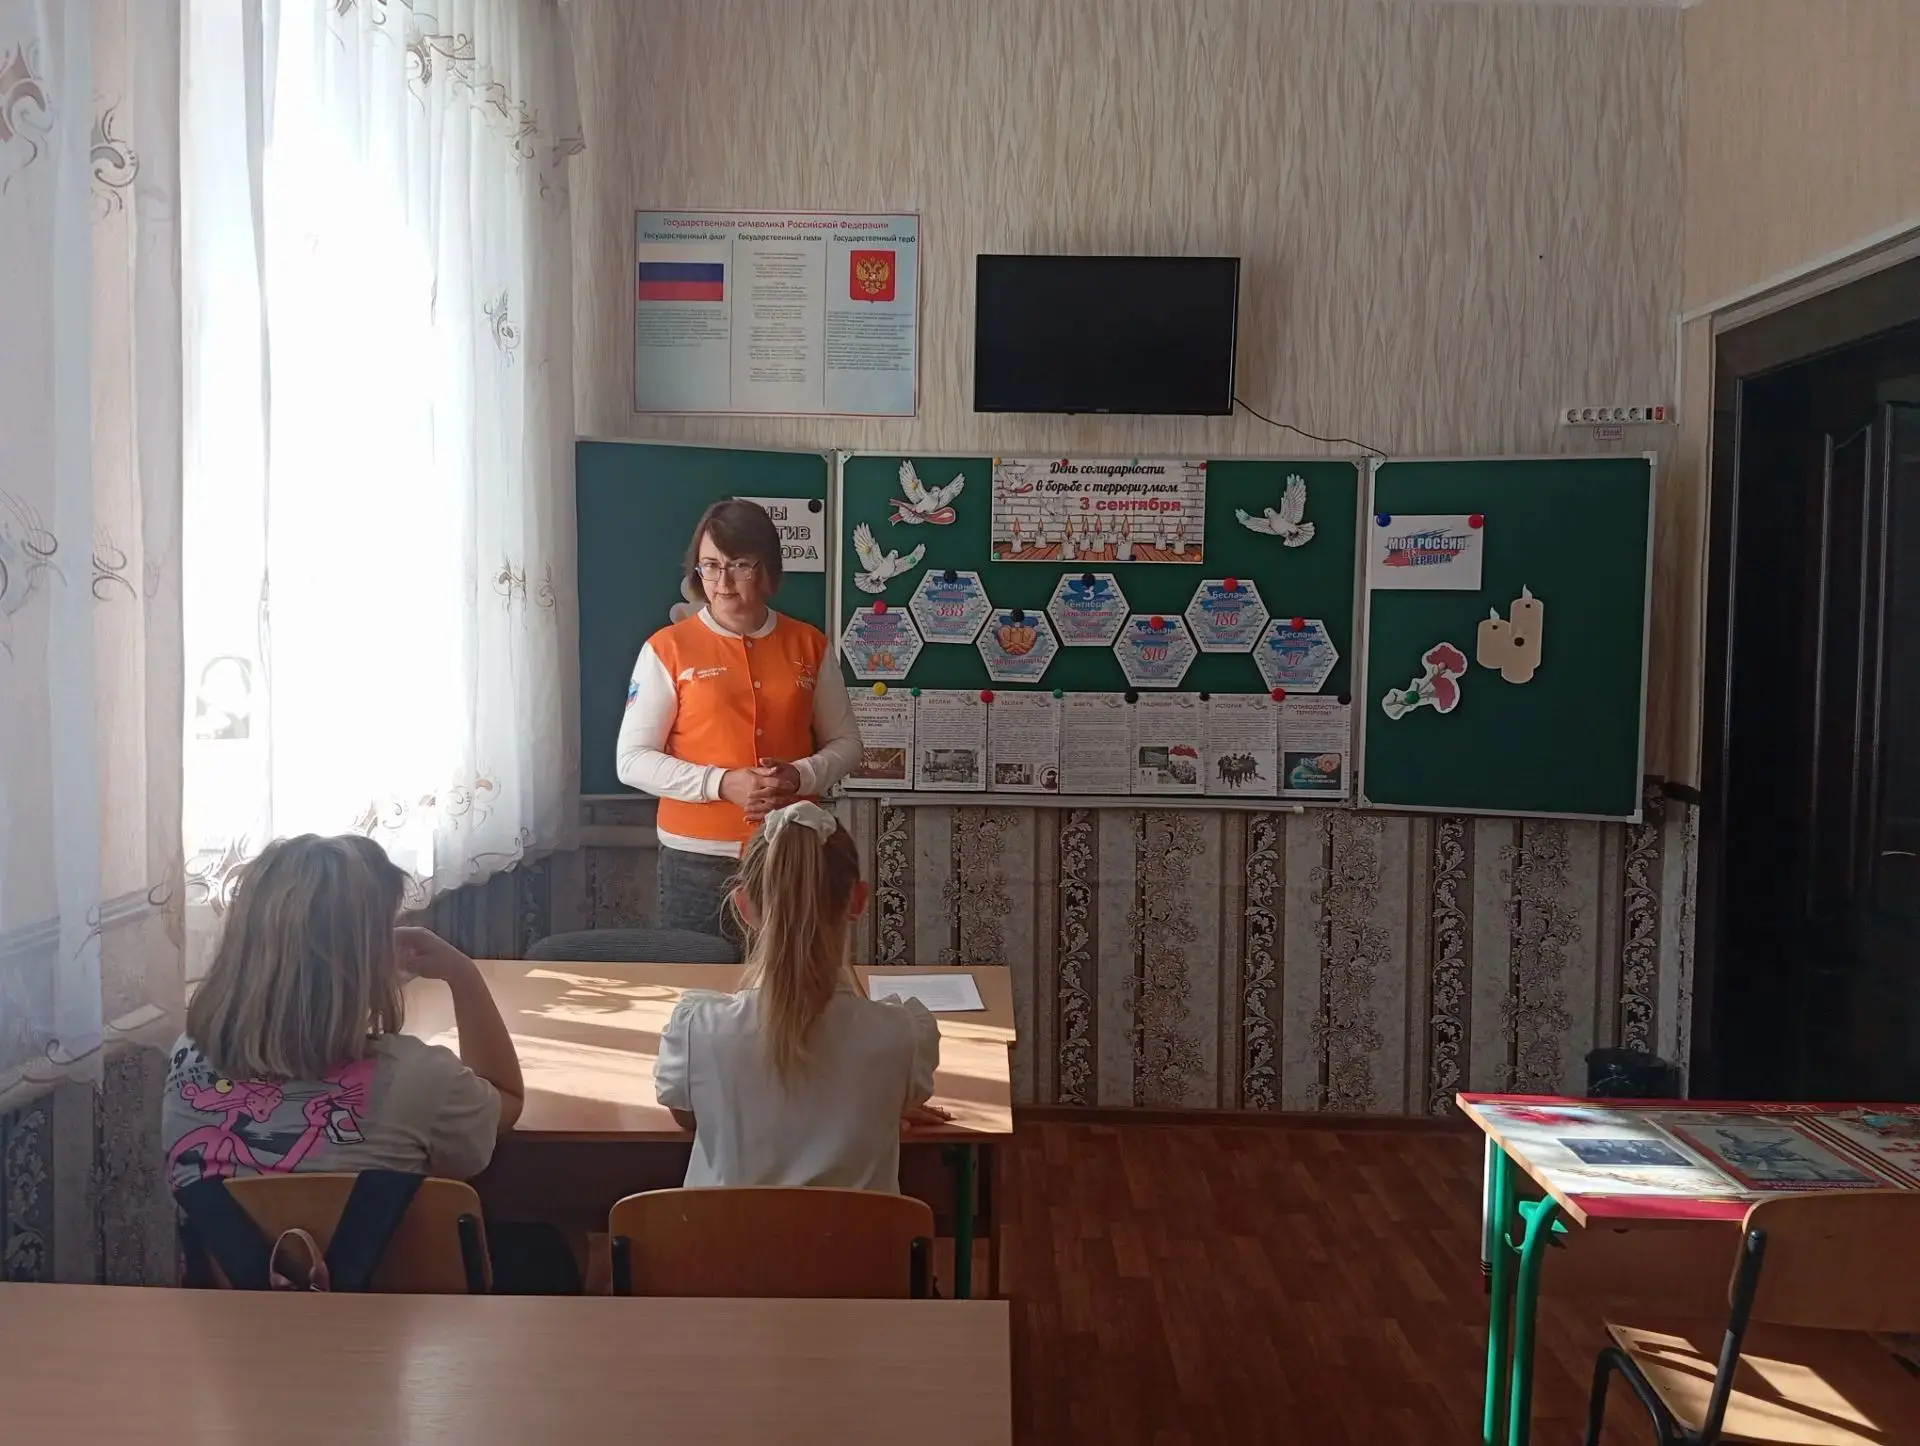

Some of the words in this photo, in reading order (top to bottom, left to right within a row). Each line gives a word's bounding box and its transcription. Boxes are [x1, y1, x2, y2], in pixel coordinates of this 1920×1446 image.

[663, 218, 735, 228] Государственная
[737, 220, 784, 229] символика
[787, 219, 838, 229] Российской
[840, 220, 888, 230] Федерации
[644, 232, 707, 242] Государственный
[738, 232, 801, 242] Государственный
[833, 233, 896, 243] Государственный
[898, 235, 916, 244] герб
[1050, 461, 1078, 474] День
[1080, 465, 1165, 477] солидарности
[1036, 480, 1043, 491] в
[1045, 480, 1081, 495] борьбе
[1084, 483, 1091, 492] с
[1092, 483, 1178, 495] терроризмом
[1079, 497, 1089, 511] 3
[1096, 498, 1181, 514] сентября
[1388, 537, 1413, 550] МОЯ
[1417, 537, 1465, 550] РОССИЯ
[1082, 585, 1095, 601] 3
[1214, 611, 1239, 626] 186
[1142, 647, 1168, 661] 810
